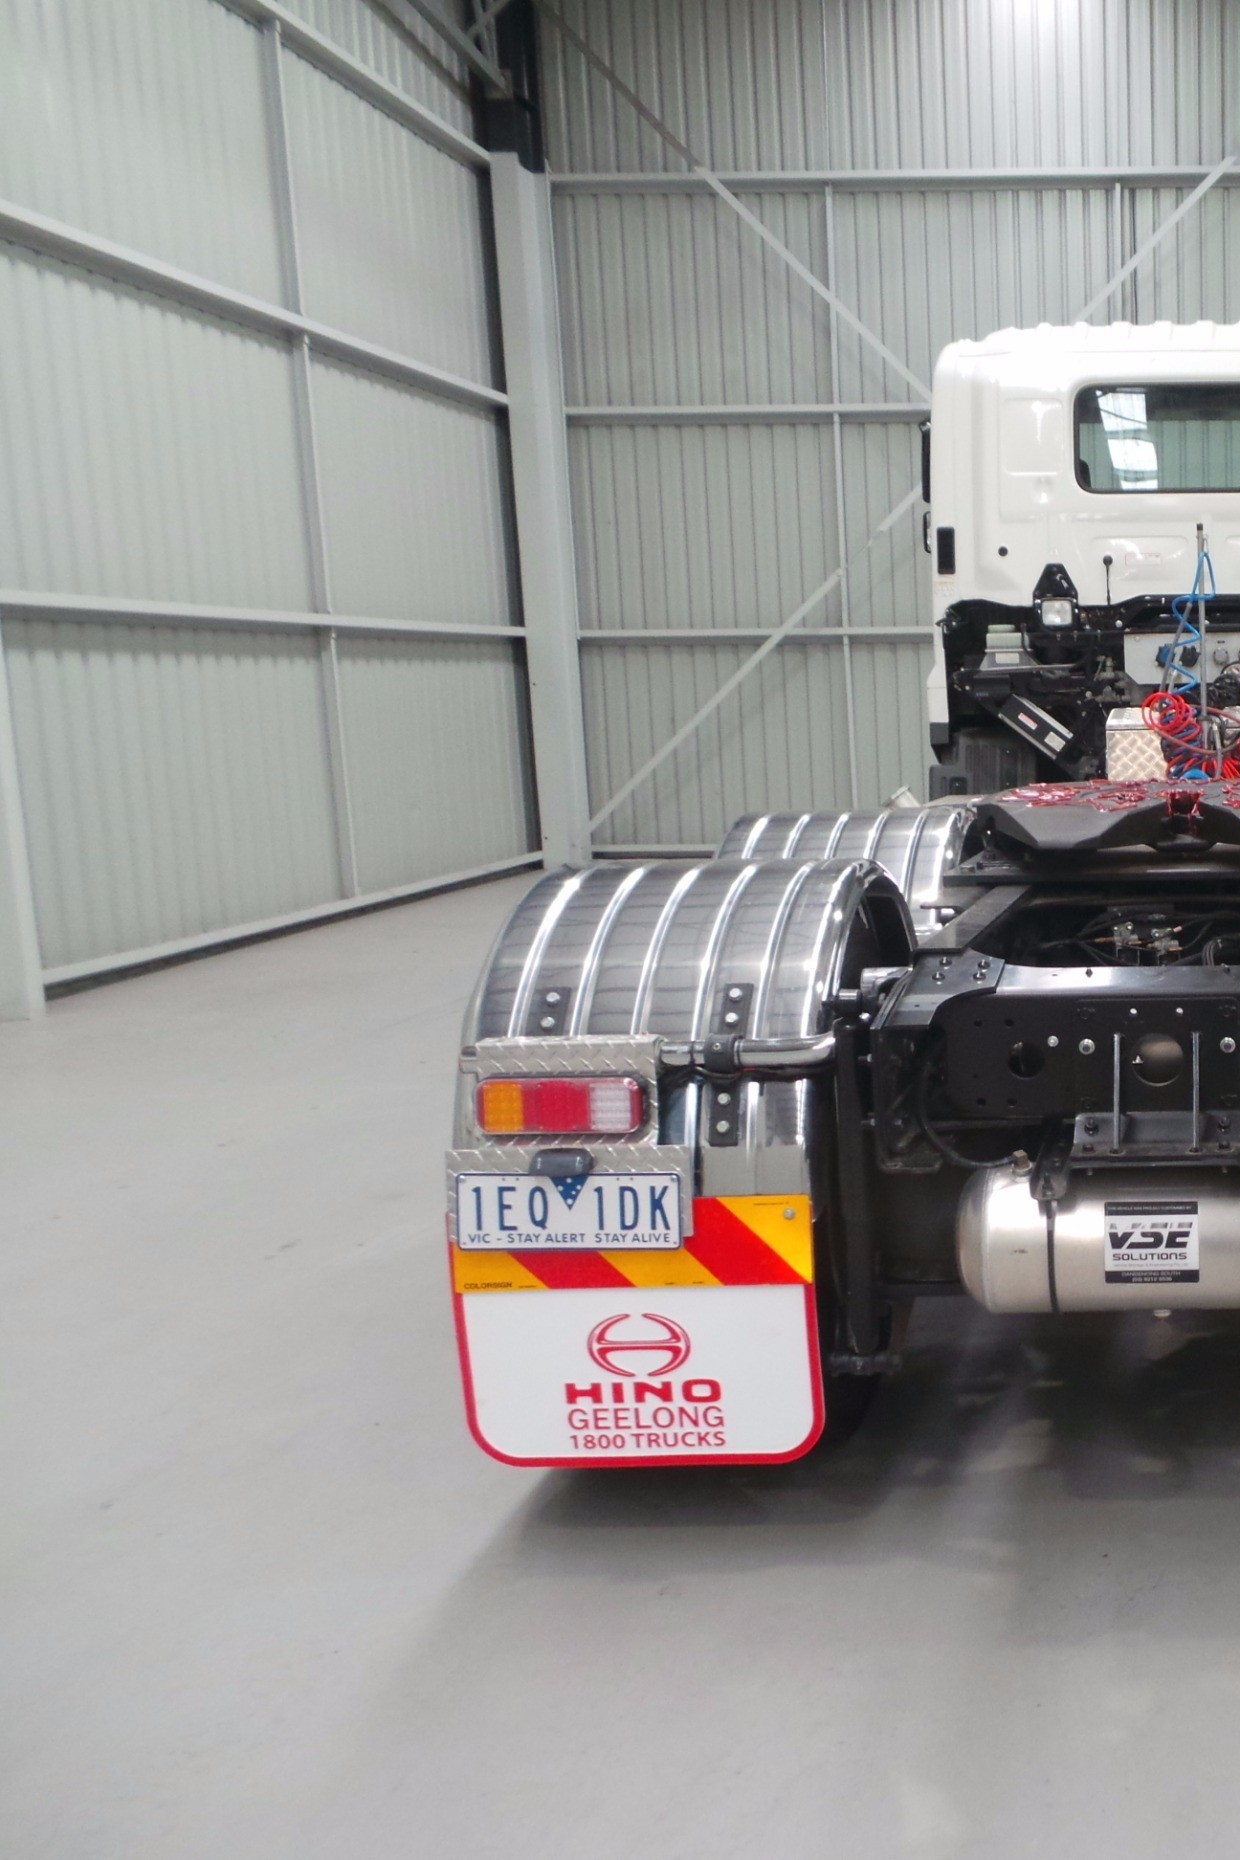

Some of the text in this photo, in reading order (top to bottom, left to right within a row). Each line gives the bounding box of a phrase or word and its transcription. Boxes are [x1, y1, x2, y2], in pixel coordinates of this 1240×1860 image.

[471, 1185, 671, 1231] 1EQ 1DK
[467, 1233, 491, 1244] VIC
[508, 1233, 541, 1243] STAY
[545, 1233, 586, 1243] ALERT
[594, 1233, 627, 1243] STAY
[631, 1233, 671, 1243] ALIVE
[1112, 1252, 1188, 1261] SOLUTIONS
[463, 1281, 512, 1290] COLORSIGN
[565, 1378, 722, 1405] HINO
[567, 1405, 725, 1431] GEELONG
[569, 1431, 726, 1450] 1800 TRUCKS
